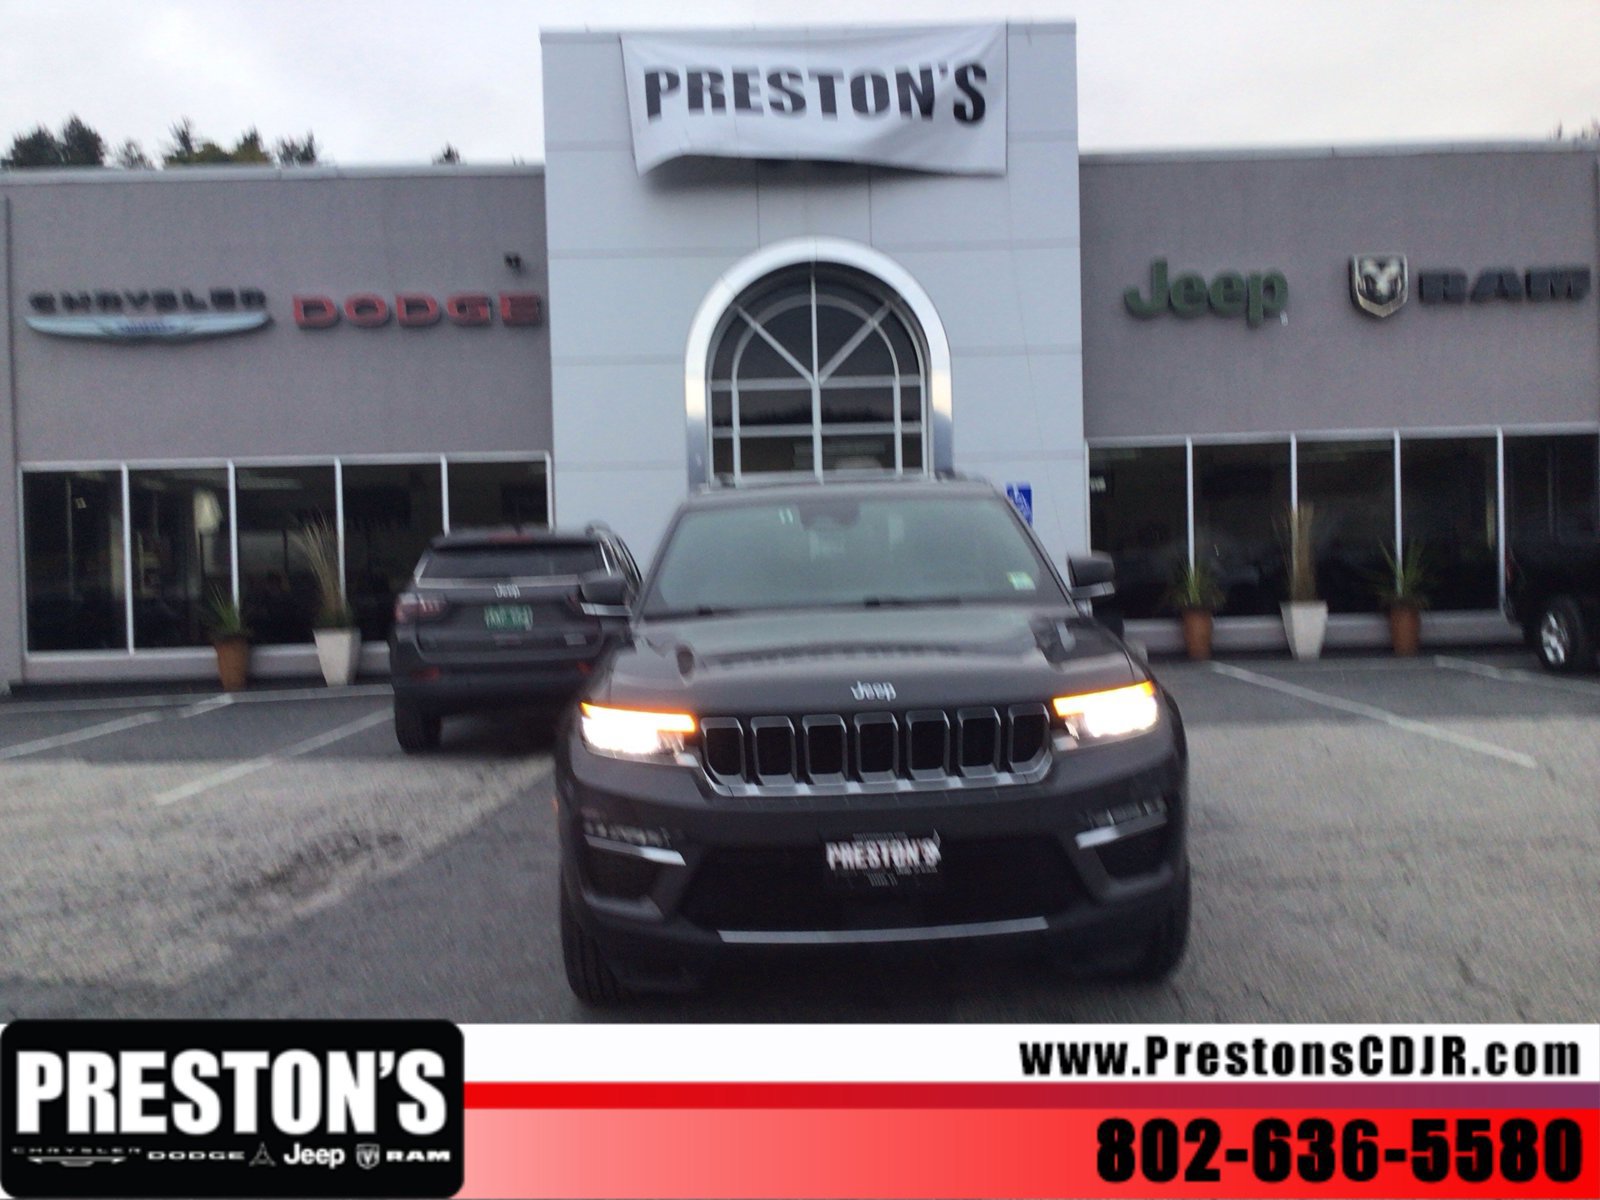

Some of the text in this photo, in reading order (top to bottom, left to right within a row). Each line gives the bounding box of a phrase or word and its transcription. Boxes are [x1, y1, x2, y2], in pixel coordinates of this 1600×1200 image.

[643, 60, 988, 125] PRESTON'S
[28, 287, 267, 313] CHRYSLER
[1123, 256, 1289, 328] Jeep
[1418, 266, 1590, 304] RAM
[292, 292, 541, 328] DODGE
[850, 680, 897, 701] Jeep
[825, 838, 942, 871] PRESTON'S
